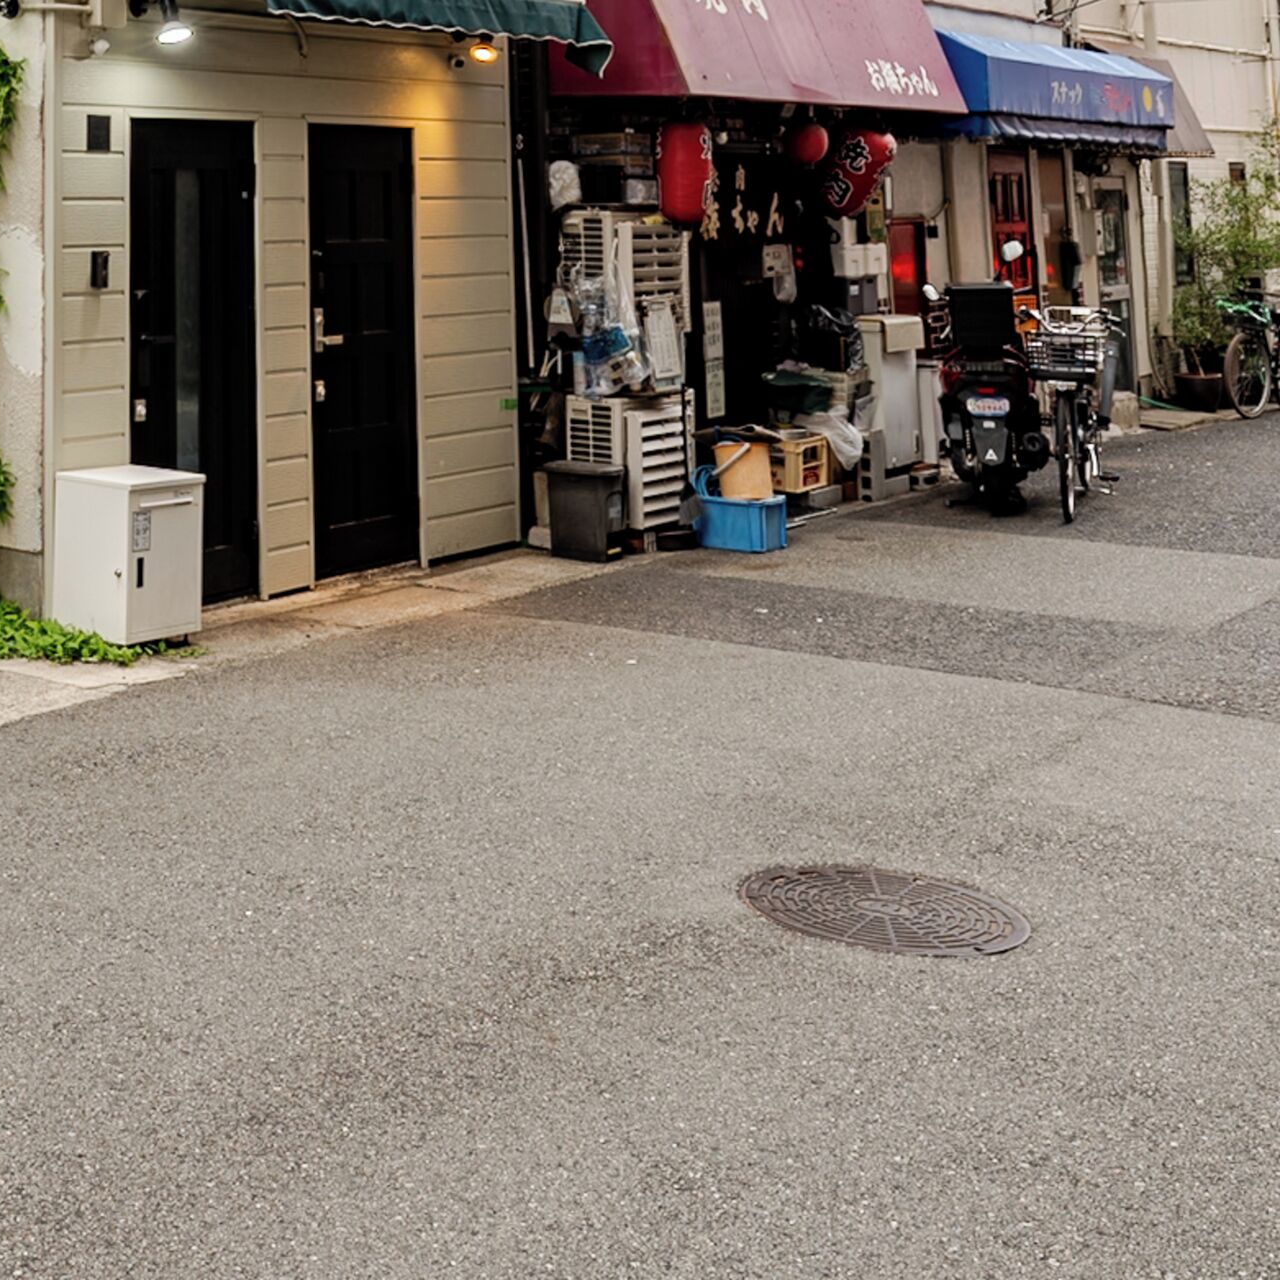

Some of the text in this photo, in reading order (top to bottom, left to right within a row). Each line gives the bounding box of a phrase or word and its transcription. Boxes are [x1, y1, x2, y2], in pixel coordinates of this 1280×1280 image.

[864, 59, 939, 97] お梅ちゃん
